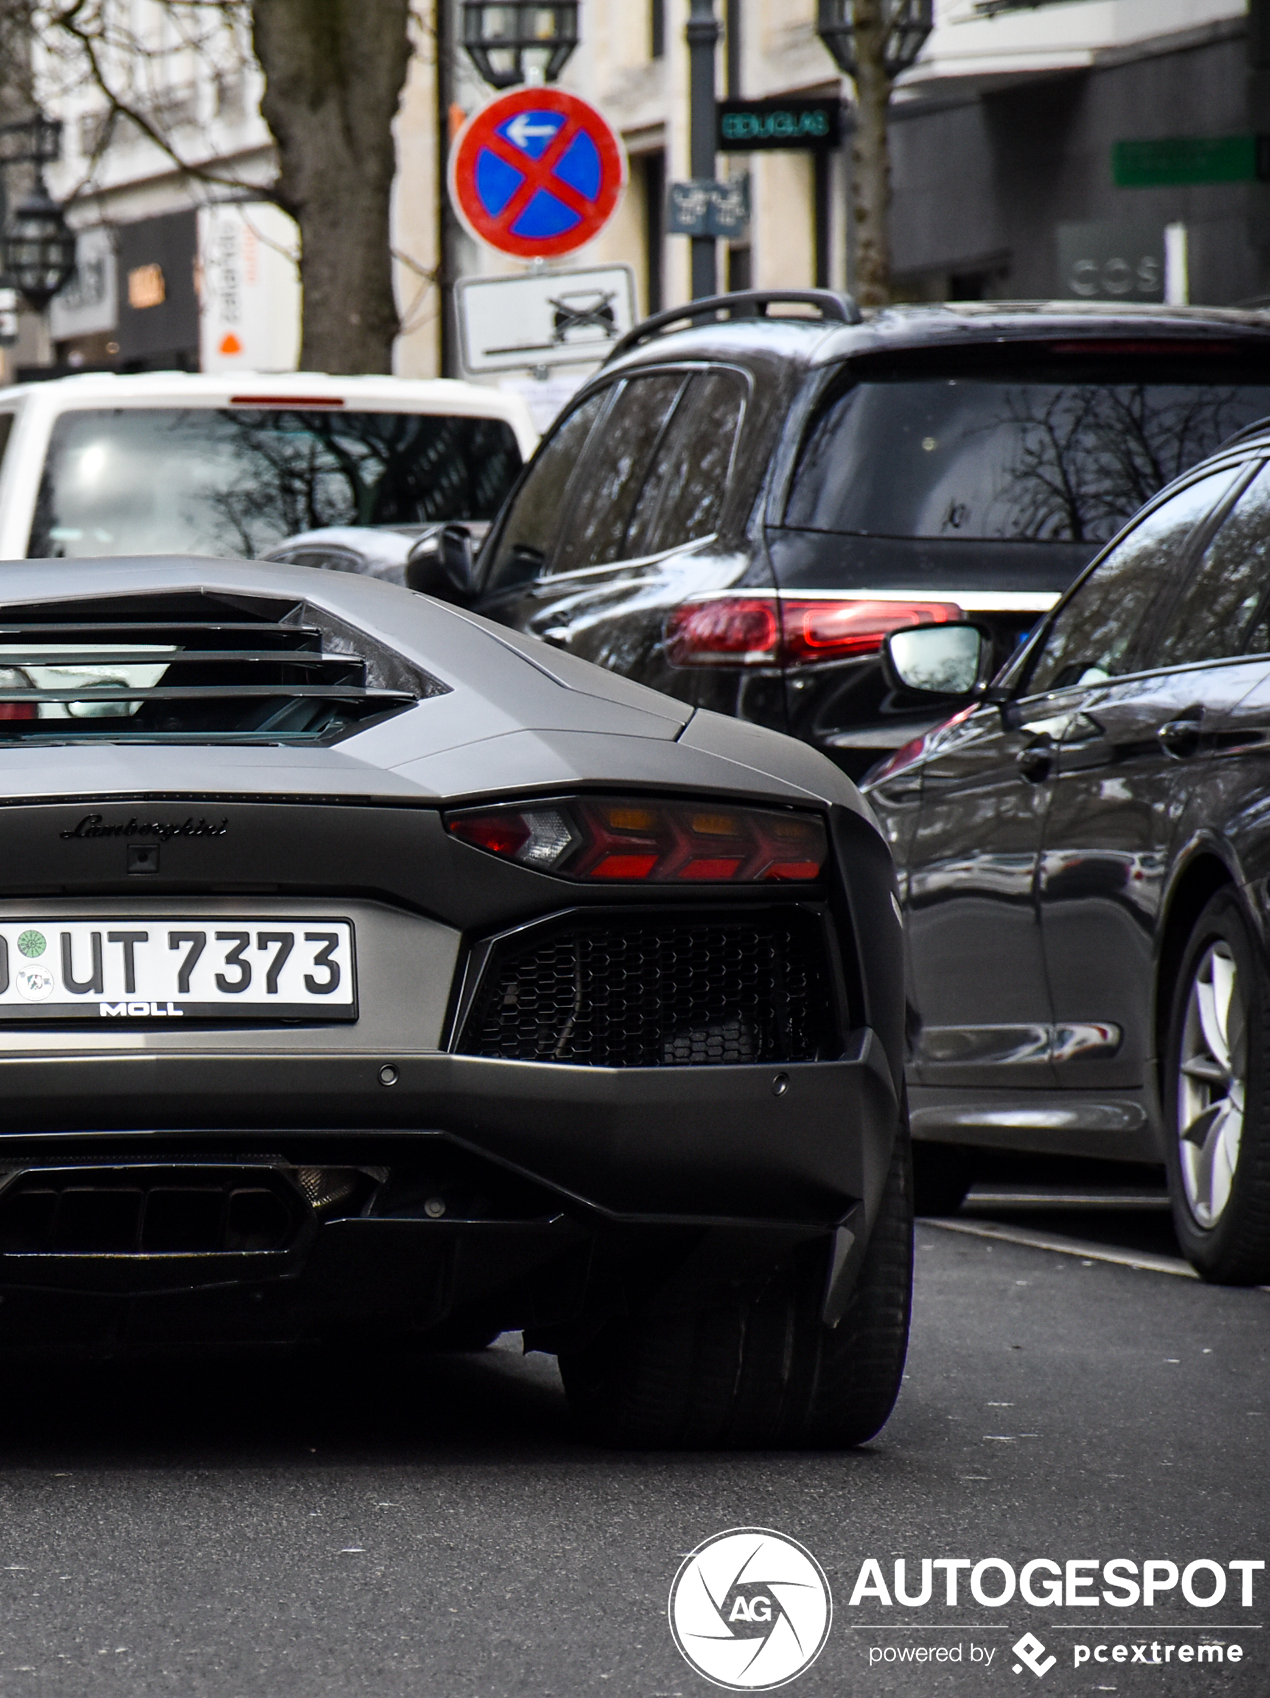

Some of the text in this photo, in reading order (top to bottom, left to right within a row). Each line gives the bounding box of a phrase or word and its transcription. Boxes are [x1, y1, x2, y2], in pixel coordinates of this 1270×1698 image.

[1070, 256, 1160, 296] COS
[60, 813, 228, 842] Lamborghini
[60, 931, 149, 995] UT
[167, 931, 341, 995] 7373
[99, 1002, 185, 1017] MOLL
